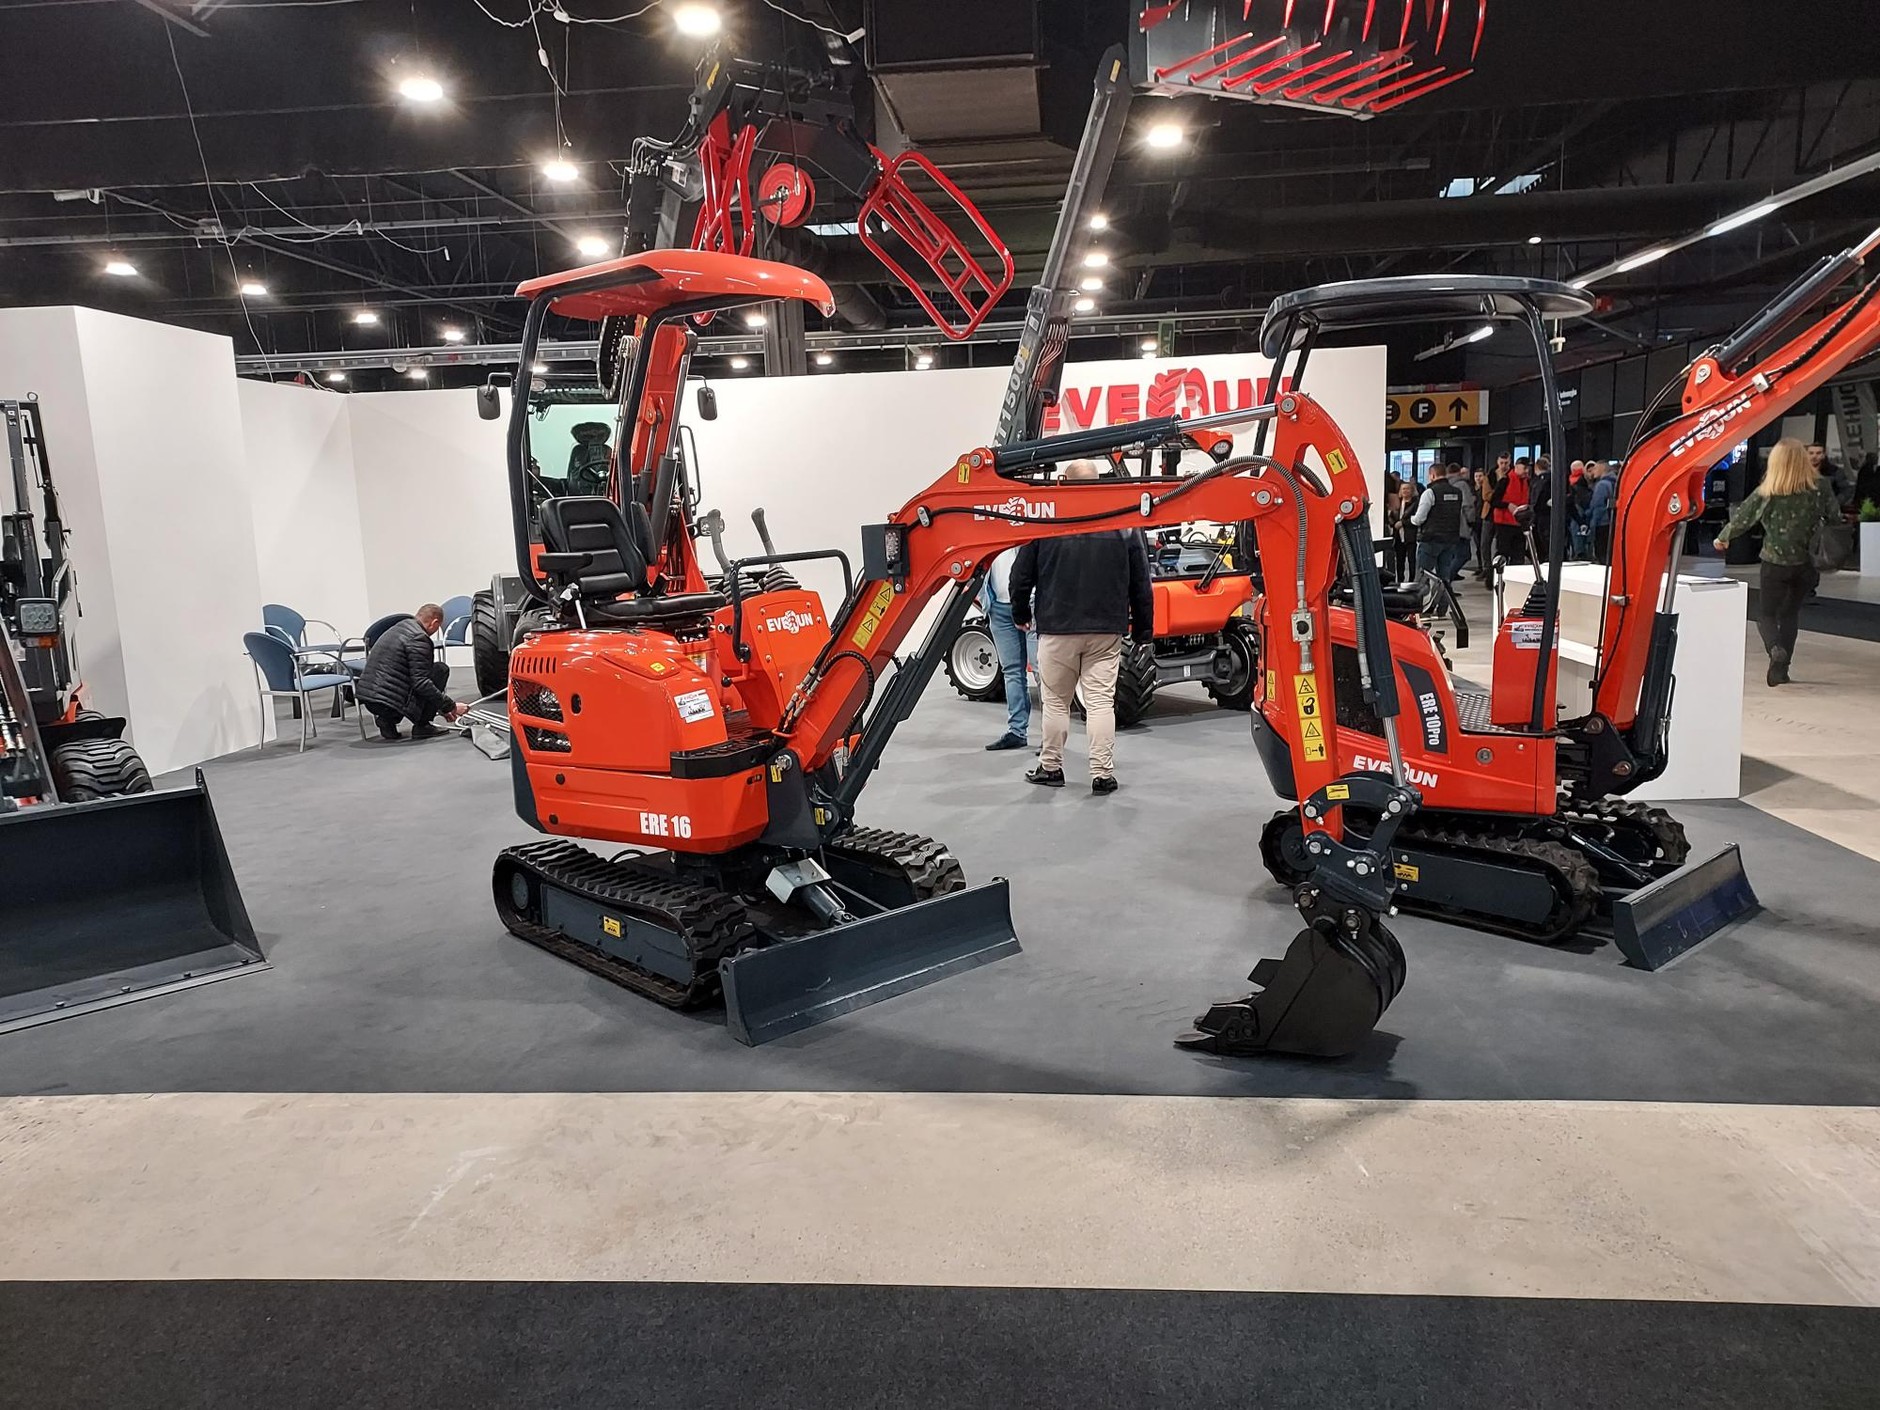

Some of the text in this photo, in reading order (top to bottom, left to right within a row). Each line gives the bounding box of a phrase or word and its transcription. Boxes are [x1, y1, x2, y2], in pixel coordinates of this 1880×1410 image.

[1418, 402, 1429, 419] F
[765, 610, 814, 635] EVERUN
[1419, 692, 1438, 714] ERE
[640, 812, 692, 839] ERE 16
